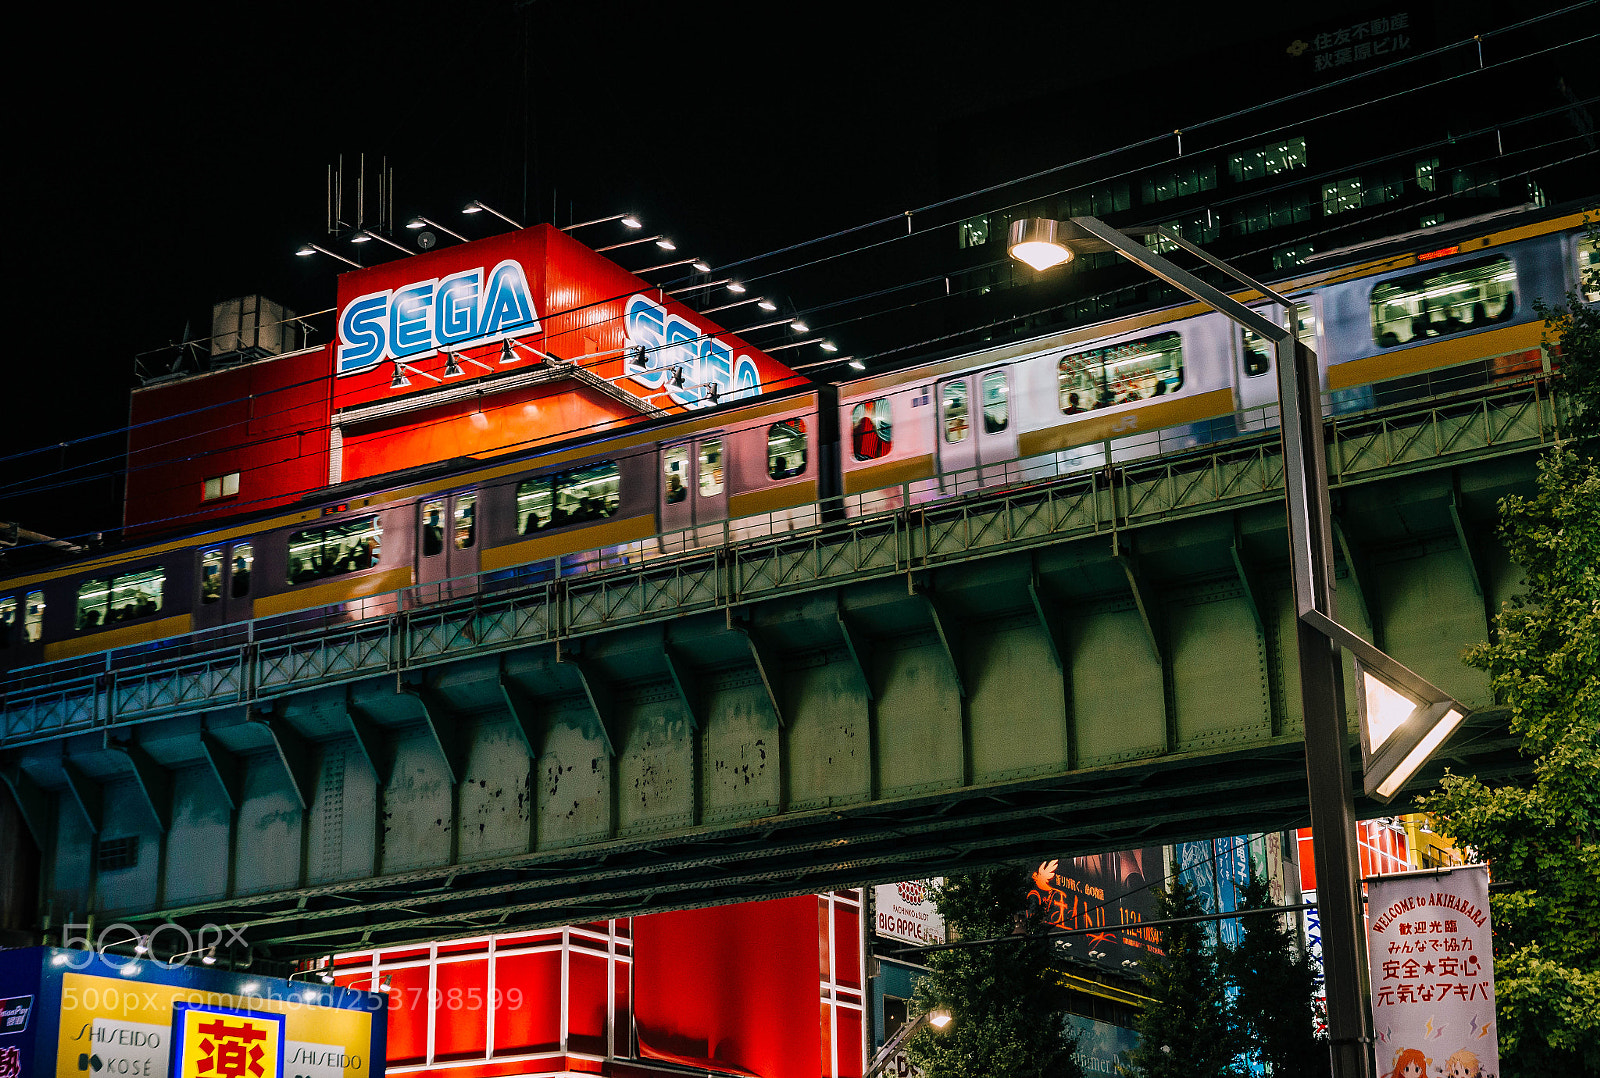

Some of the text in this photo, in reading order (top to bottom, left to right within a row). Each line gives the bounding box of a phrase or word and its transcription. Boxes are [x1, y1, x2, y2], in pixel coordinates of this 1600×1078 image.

[1313, 11, 1409, 51] 住友不動産
[1314, 33, 1411, 72] 秋葉原ビル
[336, 258, 542, 378] SEGA
[623, 293, 764, 412] SEGA
[879, 912, 895, 932] BIG
[897, 917, 922, 940] APPLE
[1372, 892, 1488, 934] WELCOME to AKIHABARA
[1399, 919, 1459, 936] 歓迎光臨
[1388, 936, 1473, 955] みんなで協力
[1377, 981, 1490, 1007] 元気なアキバ
[70, 1023, 161, 1049] SHISEIDO
[195, 1019, 267, 1078] 薬
[106, 1057, 152, 1077] KOSÉ
[287, 1046, 362, 1070] SHISEIDO
